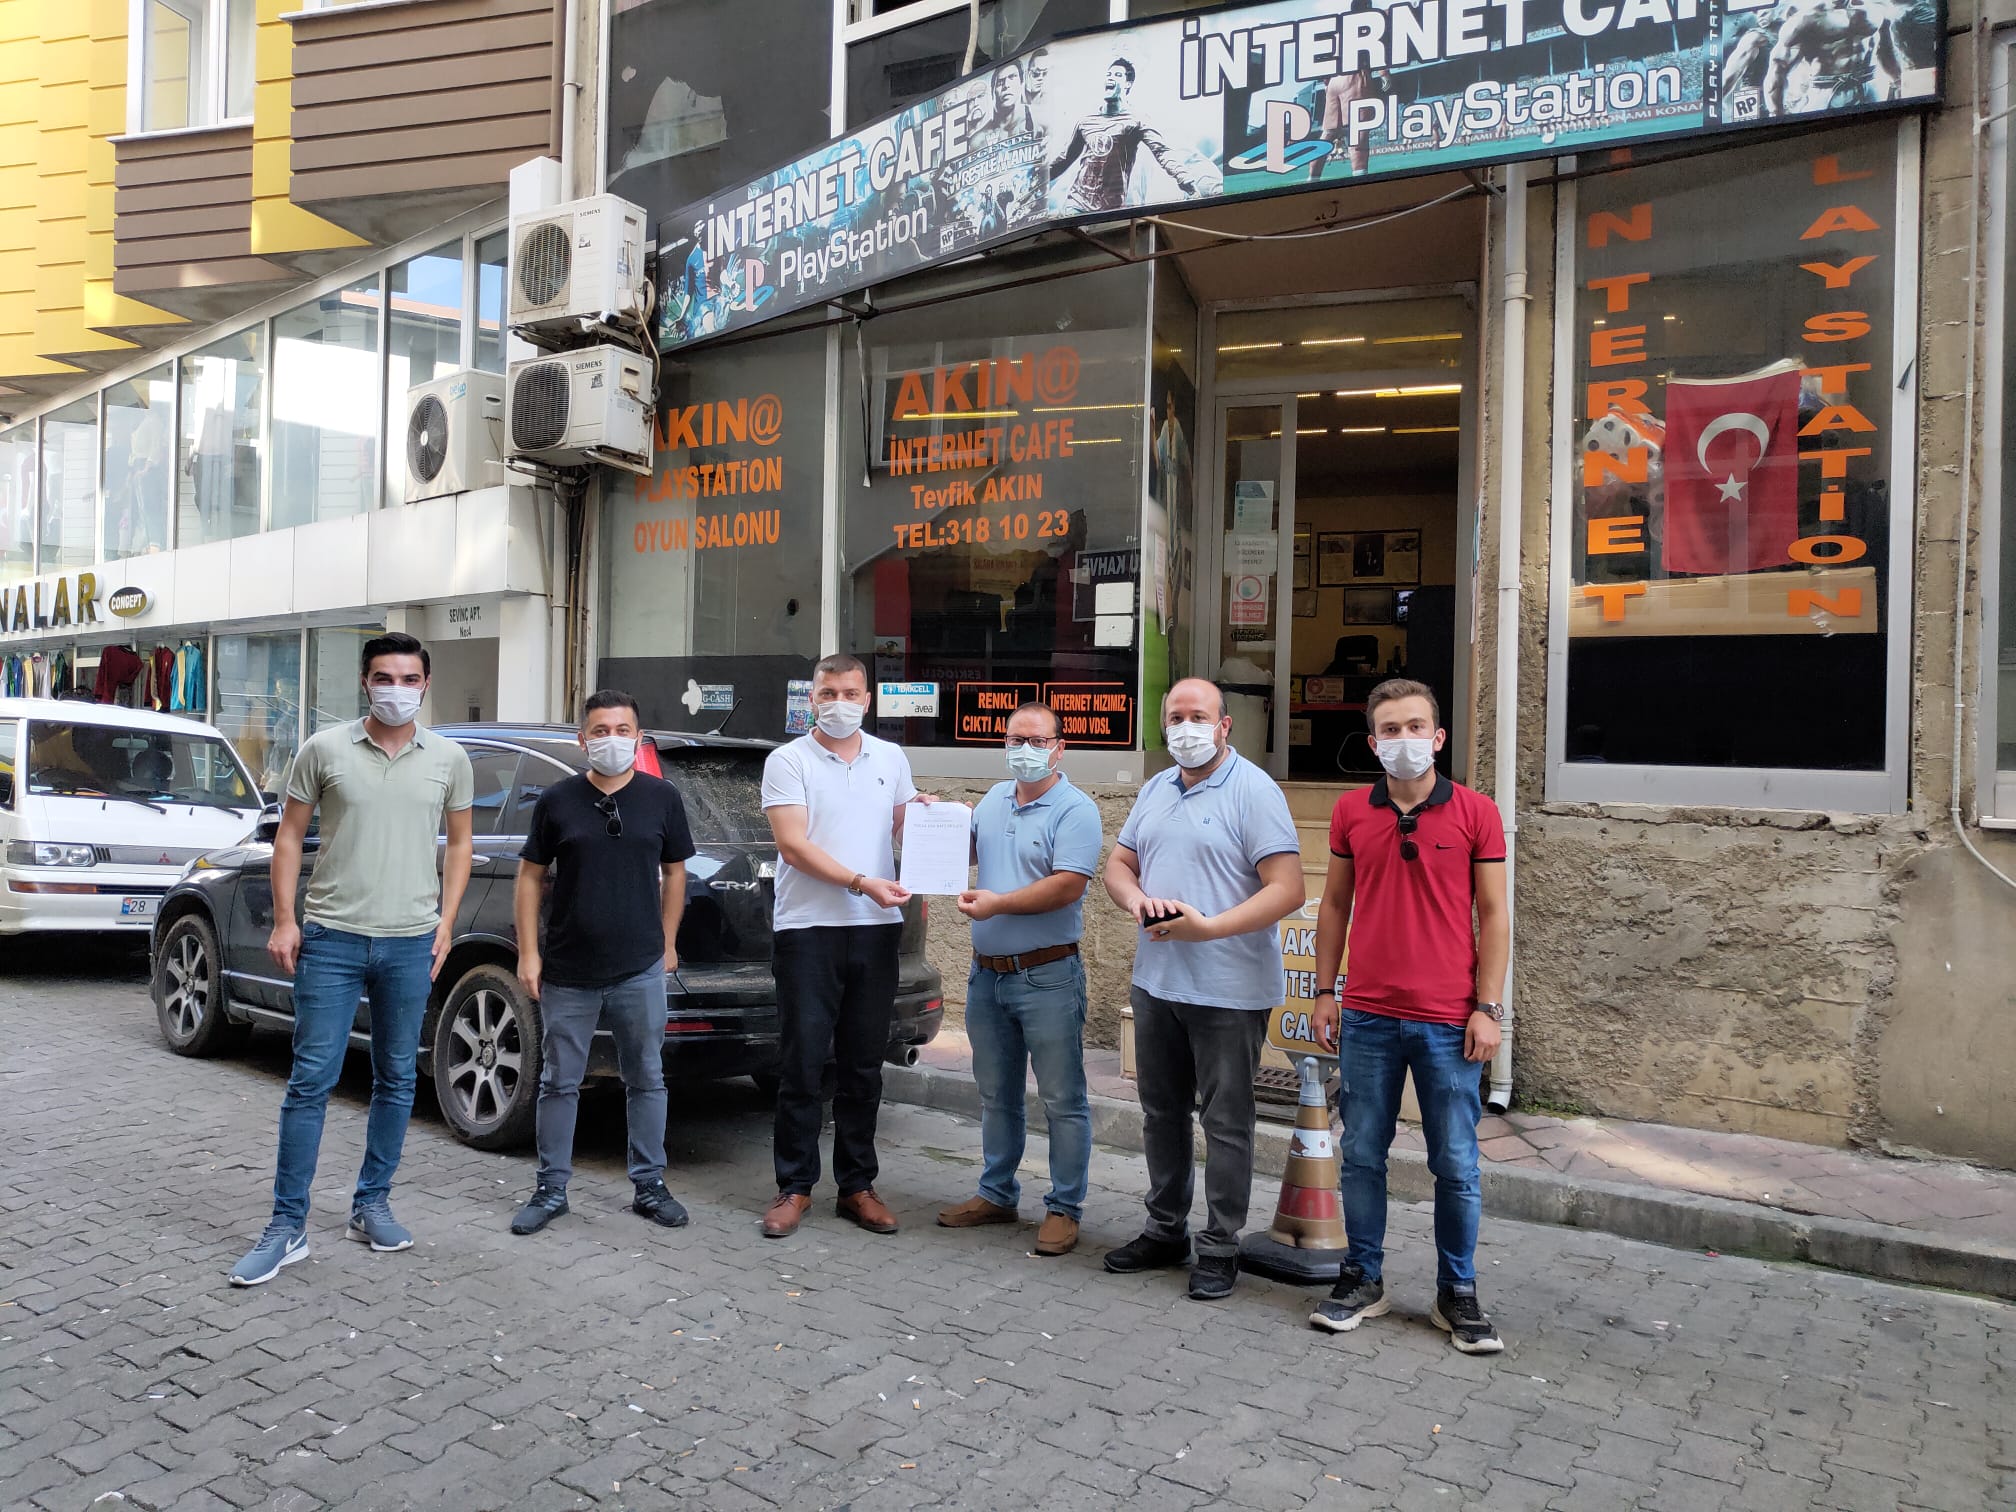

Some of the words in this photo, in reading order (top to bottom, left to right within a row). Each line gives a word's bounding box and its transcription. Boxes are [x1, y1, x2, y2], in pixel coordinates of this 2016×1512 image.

[1349, 64, 1682, 148] PlayStation
[1735, 96, 1757, 117] RP
[706, 152, 861, 262] İNTERNET
[870, 103, 969, 192] CAFE
[579, 208, 601, 217] SIEMENS
[780, 206, 928, 288] PlayStation
[575, 360, 603, 371] SIEMENS
[892, 346, 1081, 421] AKIN@
[1787, 156, 1881, 618] LAYSTATiON
[890, 427, 1004, 477] İNTERNET
[1009, 418, 1075, 463] CAFE
[911, 480, 976, 510] Tevfik
[983, 473, 1043, 503] AKIN
[634, 518, 688, 553] OYUN
[695, 509, 781, 549] SALONU
[1000, 513, 1029, 540] 10
[1037, 509, 1070, 538] 23
[703, 694, 731, 703] G-CASH
[914, 705, 933, 713] avea
[978, 689, 1019, 709] RENKLİ
[1050, 690, 1092, 712] İNTERNET
[1093, 694, 1127, 712] HIZIMIZ
[994, 717, 1007, 734] AL
[1063, 717, 1087, 734] 33000
[1088, 717, 1111, 734] VDSL
[709, 880, 758, 891] CR-V
[130, 900, 146, 912] 28
[1282, 928, 1317, 957] AK
[1281, 1011, 1331, 1043] CA
